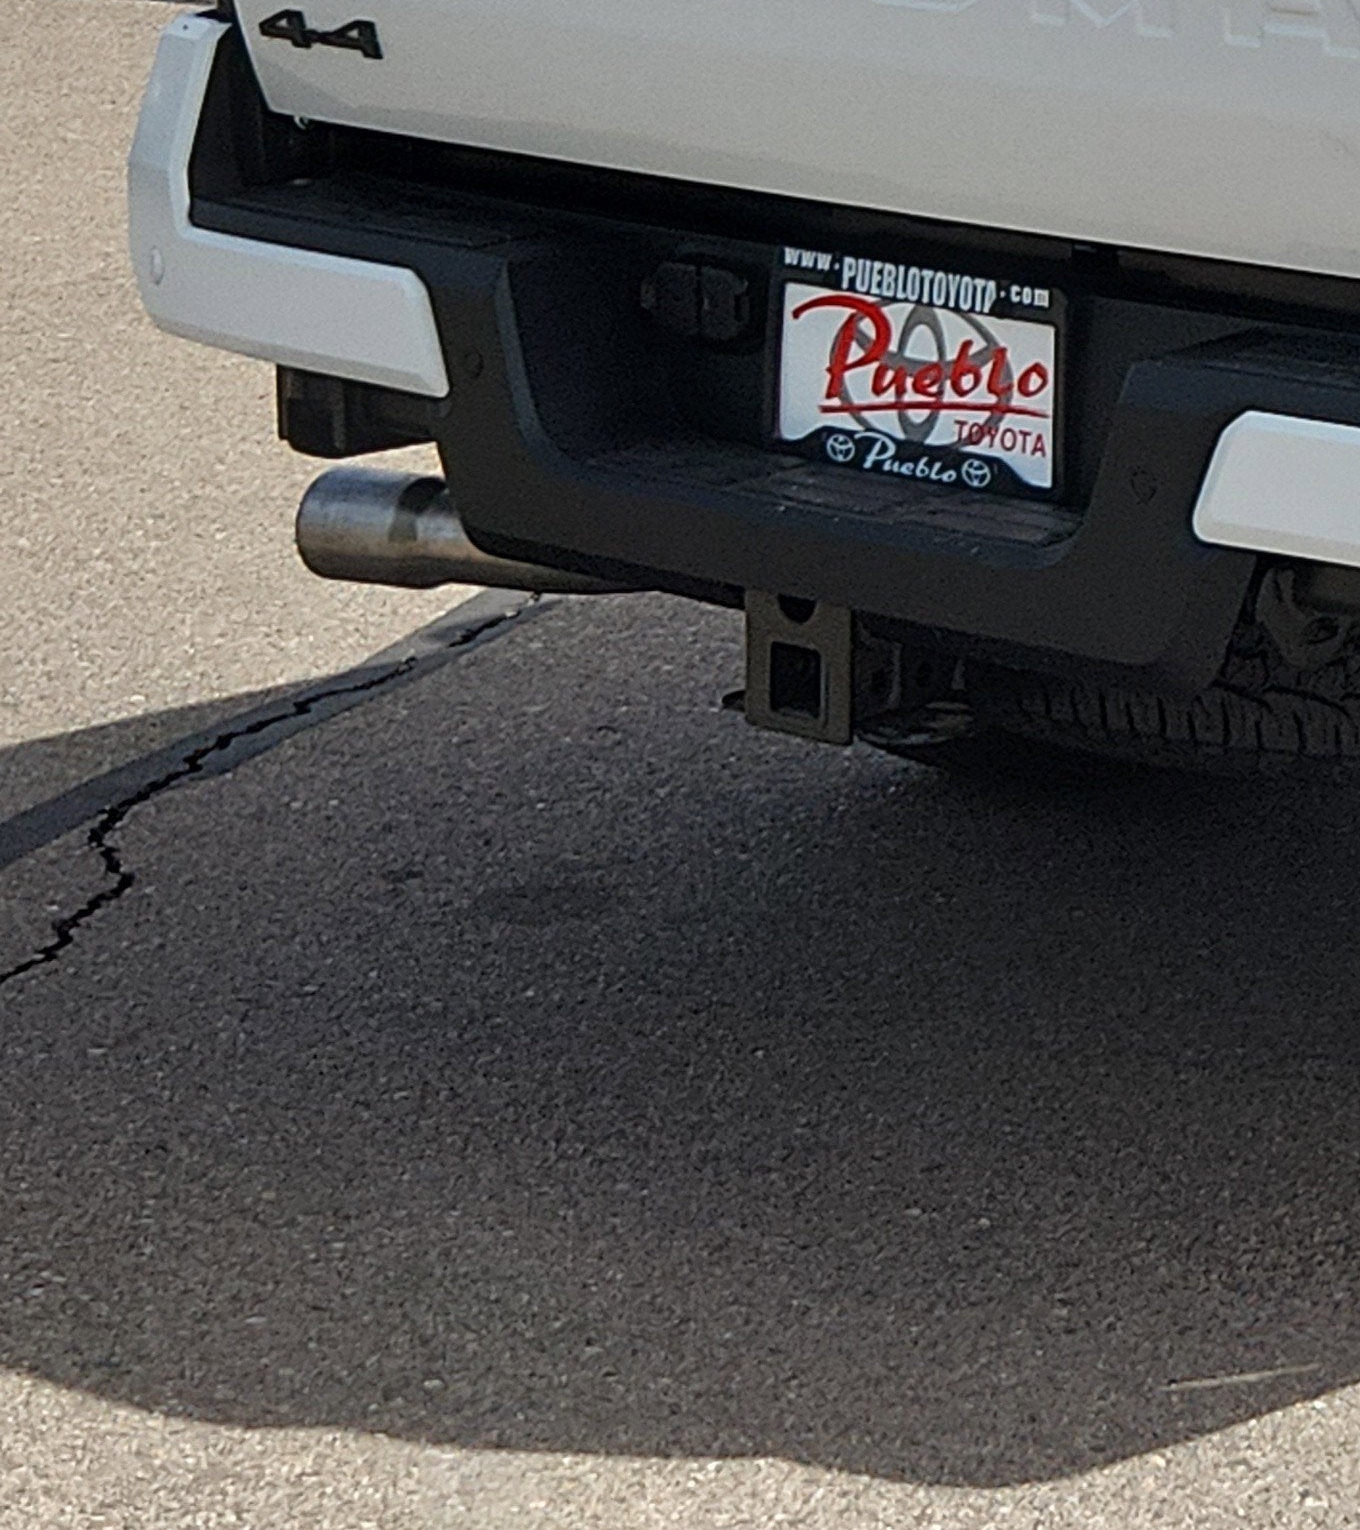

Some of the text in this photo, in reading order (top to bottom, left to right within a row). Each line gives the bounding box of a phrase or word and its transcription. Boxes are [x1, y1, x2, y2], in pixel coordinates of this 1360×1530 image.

[791, 294, 1049, 400] Pueblo
[853, 430, 957, 484] Pueblo
[954, 419, 1047, 458] TOYOTA
